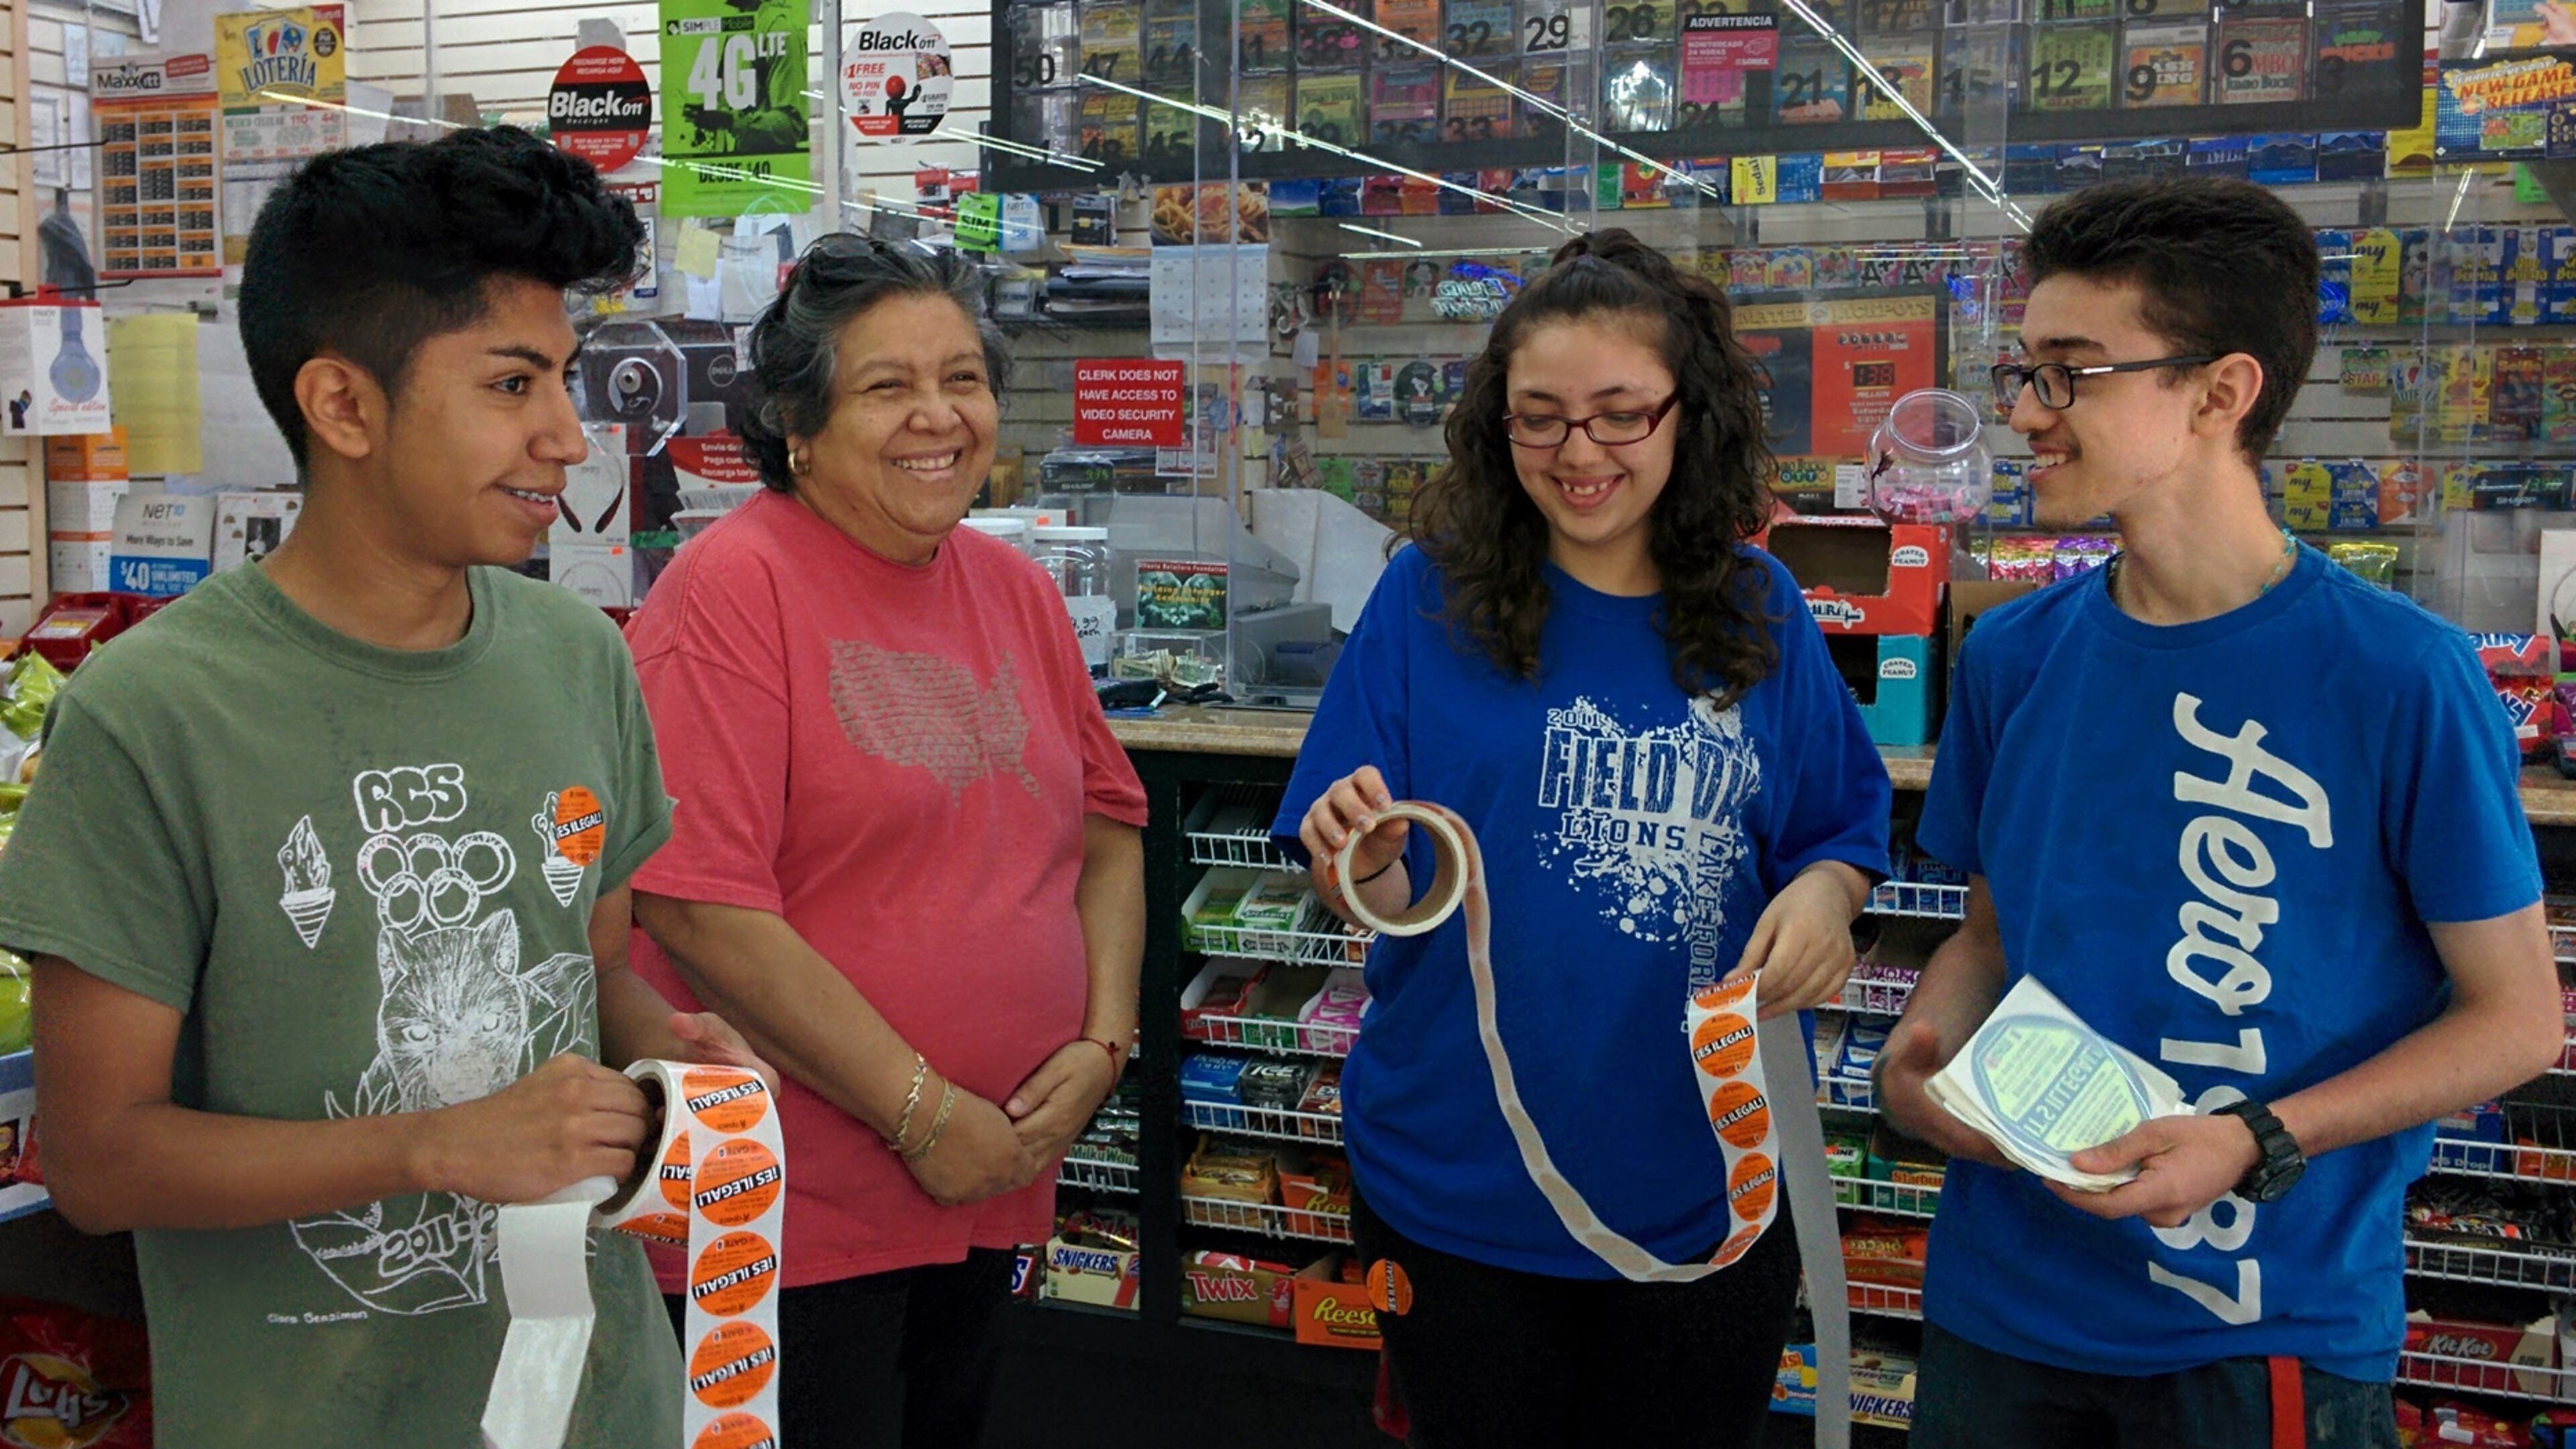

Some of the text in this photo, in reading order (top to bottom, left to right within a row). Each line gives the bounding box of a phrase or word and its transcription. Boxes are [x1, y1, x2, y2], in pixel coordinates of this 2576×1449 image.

[1525, 15, 1568, 52] 29
[1690, 15, 1773, 28] ADVERTENCIA
[859, 30, 936, 51] Black 011
[688, 32, 790, 111] 4G LTE
[856, 63, 885, 74] FREE
[1014, 53, 1056, 88] 50
[2151, 60, 2196, 74] ASH
[2222, 39, 2252, 77] 6
[243, 53, 316, 91] LOTERÍA
[2033, 60, 2081, 97] 12
[2126, 64, 2157, 101] 9
[2460, 65, 2572, 97] NEW GAME
[1781, 68, 1822, 109] 21
[550, 91, 643, 118] Black 011
[1831, 301, 1932, 323] JACKPOTS
[712, 366, 733, 375] DELL
[1079, 370, 1178, 380] CLERK DOES NOT
[1079, 390, 1177, 400] HAVE ACCESS TO
[1081, 409, 1175, 420] VIDEO SECURITY
[1102, 429, 1152, 440] CAMERA
[1780, 470, 1829, 484] OTTO
[1895, 548, 1925, 558] COATED
[121, 561, 150, 590] $40
[1883, 660, 1913, 669] COATED
[1539, 727, 1680, 814] FIELD
[354, 762, 468, 834] RCS
[1560, 812, 1688, 851] LIONS
[2148, 692, 2334, 1326] Aero 187
[1711, 1026, 1752, 1051] ILEGAL!
[689, 1085, 741, 1112] ILEGAL!
[1729, 1097, 1766, 1123] ILEGAL!
[698, 1176, 754, 1207] ILEGAL!
[1743, 1167, 1774, 1193] ILEGAL!
[1892, 1170, 1944, 1187] Starbur
[1052, 1248, 1118, 1273] SNICKERS
[694, 1268, 751, 1298] ILEGAL!
[1185, 1270, 1258, 1302] Twix
[1313, 1296, 1377, 1326] Reese
[694, 1358, 749, 1391] ILEGAL!
[1849, 1393, 1912, 1419] NICKERS
